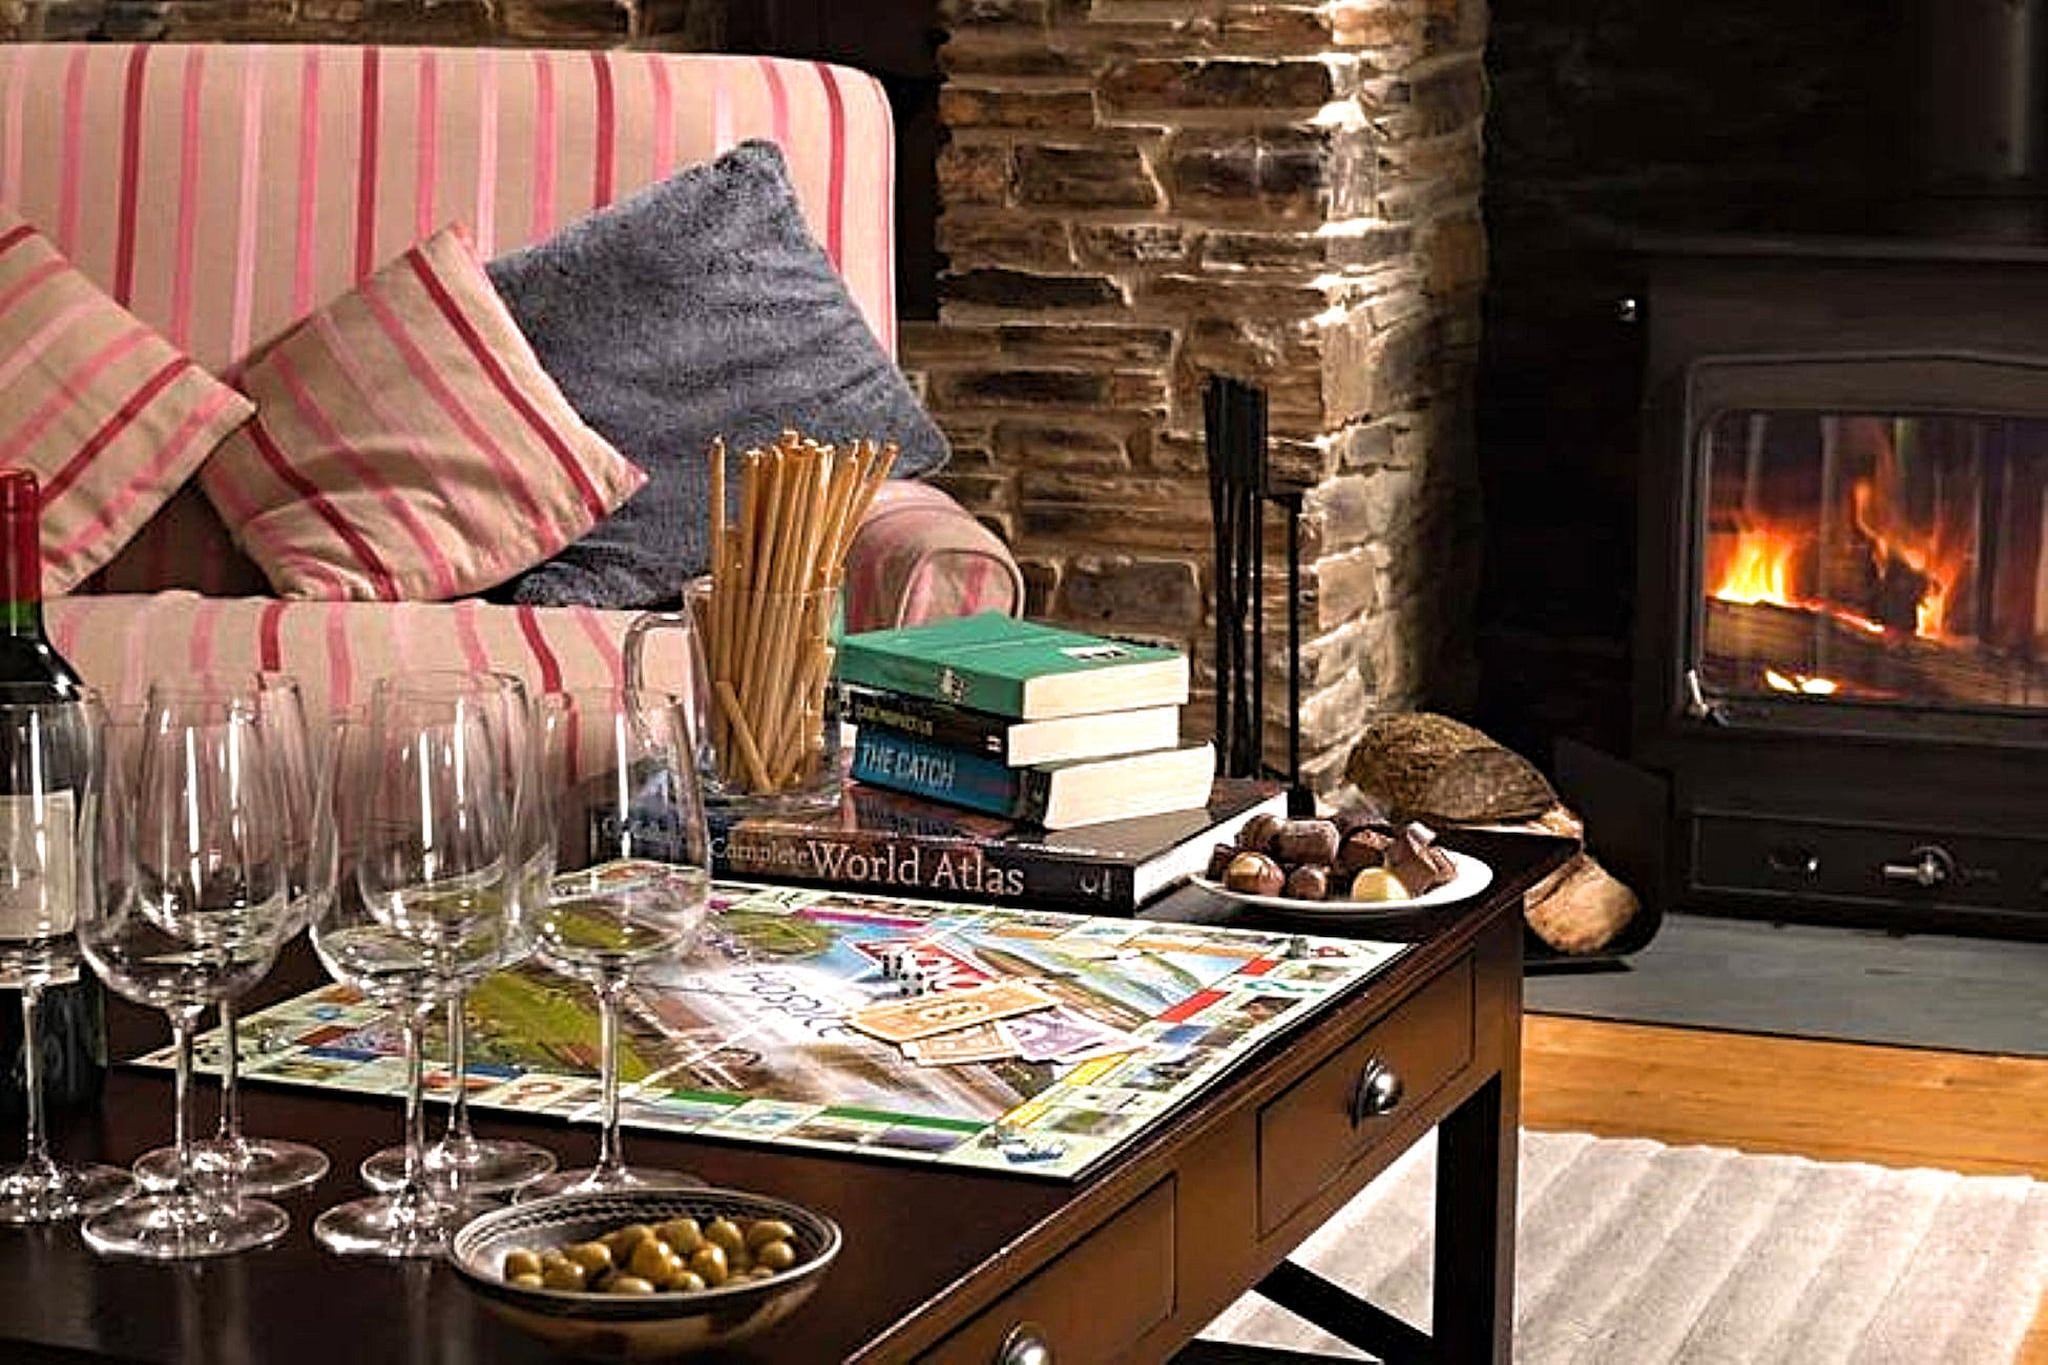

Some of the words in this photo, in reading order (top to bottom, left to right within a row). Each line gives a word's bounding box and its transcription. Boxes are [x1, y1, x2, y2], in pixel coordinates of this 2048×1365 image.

[862, 742, 896, 774] THE
[896, 753, 956, 790] CATCH
[806, 840, 920, 885] World
[930, 850, 1025, 896] Atlas
